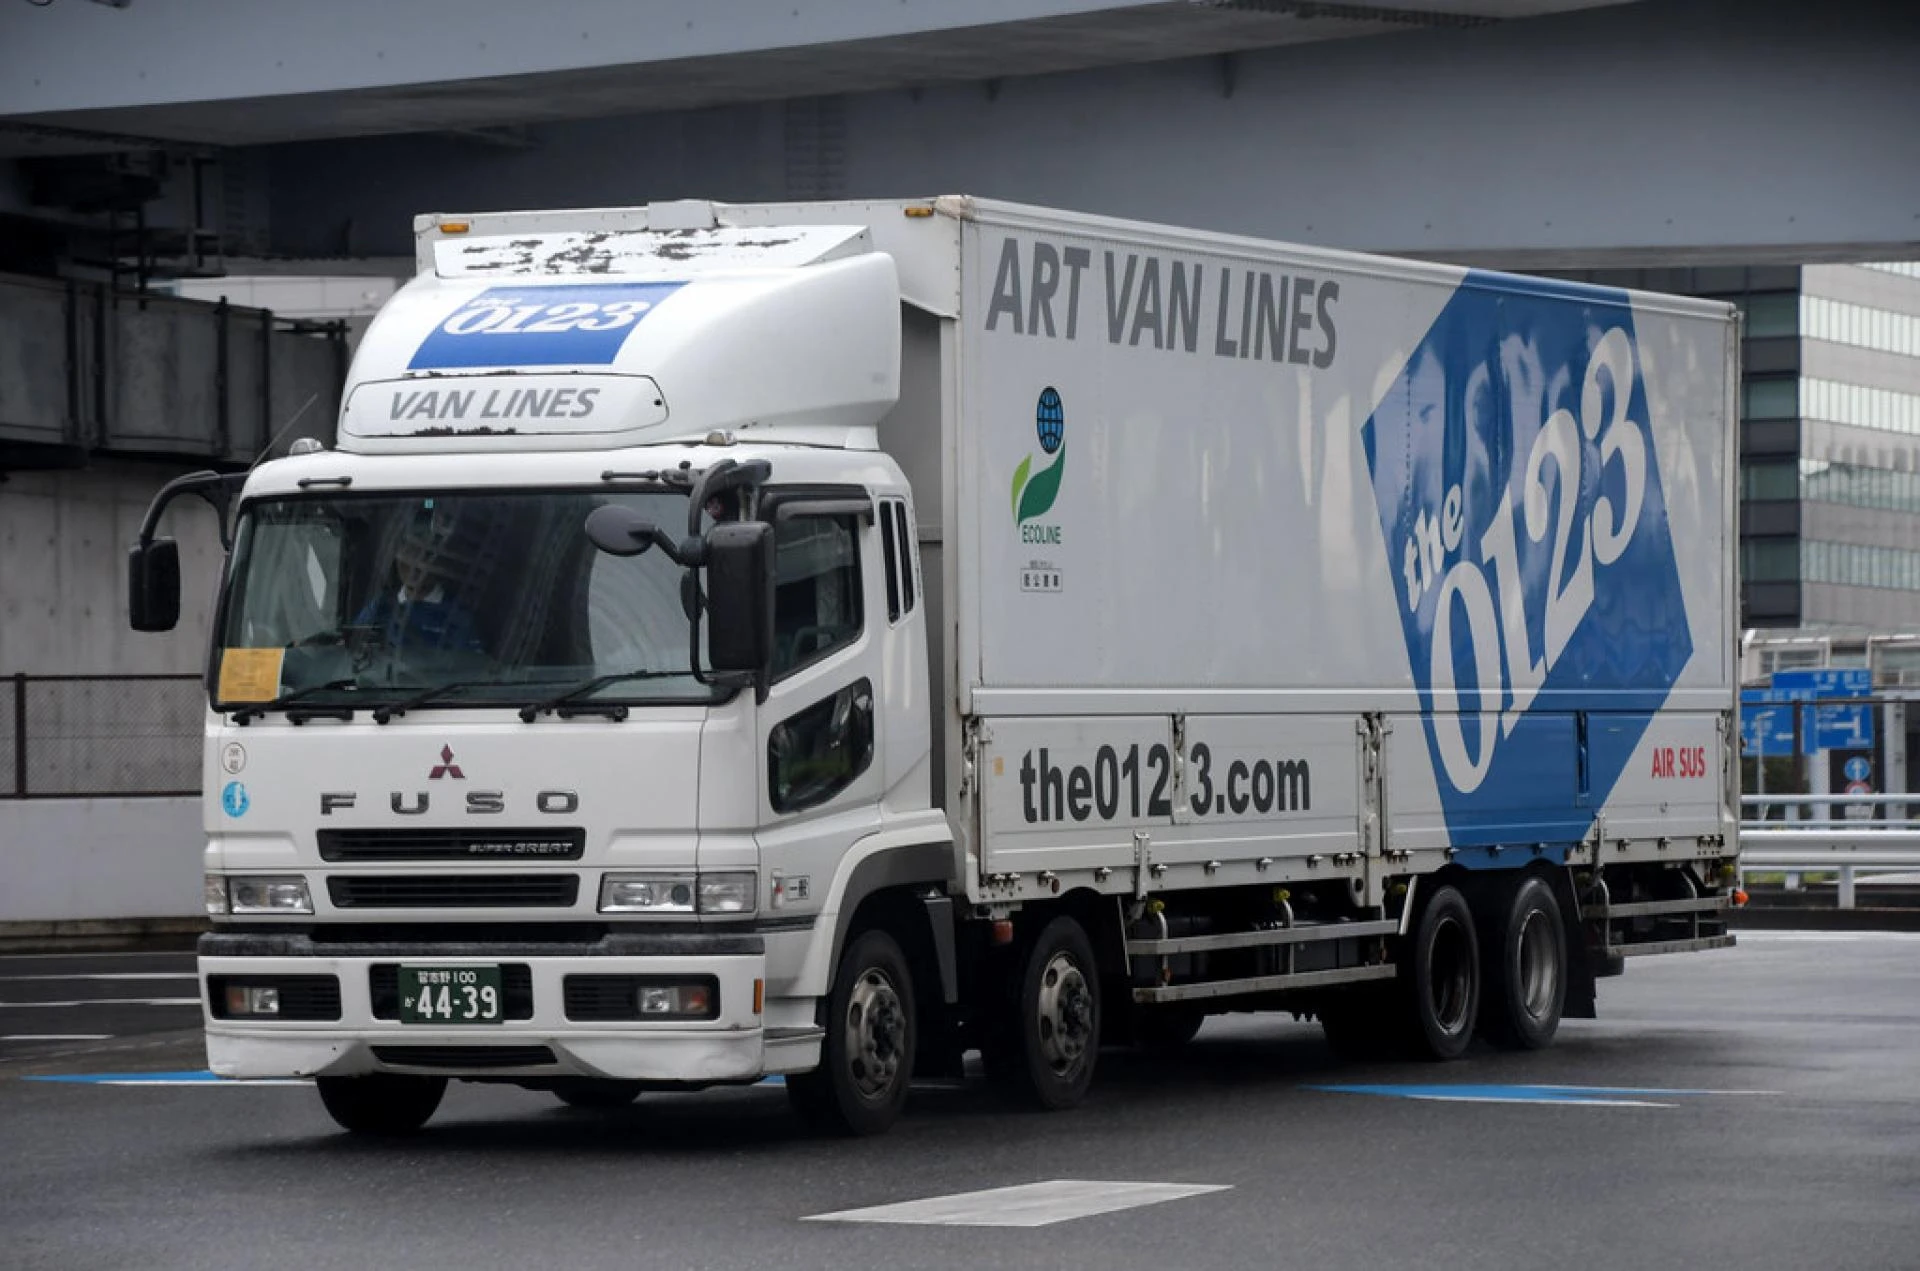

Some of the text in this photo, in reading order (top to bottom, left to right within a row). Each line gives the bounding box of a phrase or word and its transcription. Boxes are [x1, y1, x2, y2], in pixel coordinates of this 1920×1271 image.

[444, 301, 650, 334] 0123
[985, 237, 1340, 369] ART VAN LINES
[390, 388, 600, 420] VAN LINES
[1023, 524, 1061, 544] ECOLINE
[1403, 484, 1462, 613] the
[1431, 327, 1645, 794] 0123
[1652, 747, 1705, 777] AIR SUS
[1020, 742, 1311, 823] the0123.com
[320, 791, 578, 815] FUSO
[514, 843, 573, 853] GREAT
[453, 970, 477, 983] 100
[417, 985, 498, 1019] 44-39
